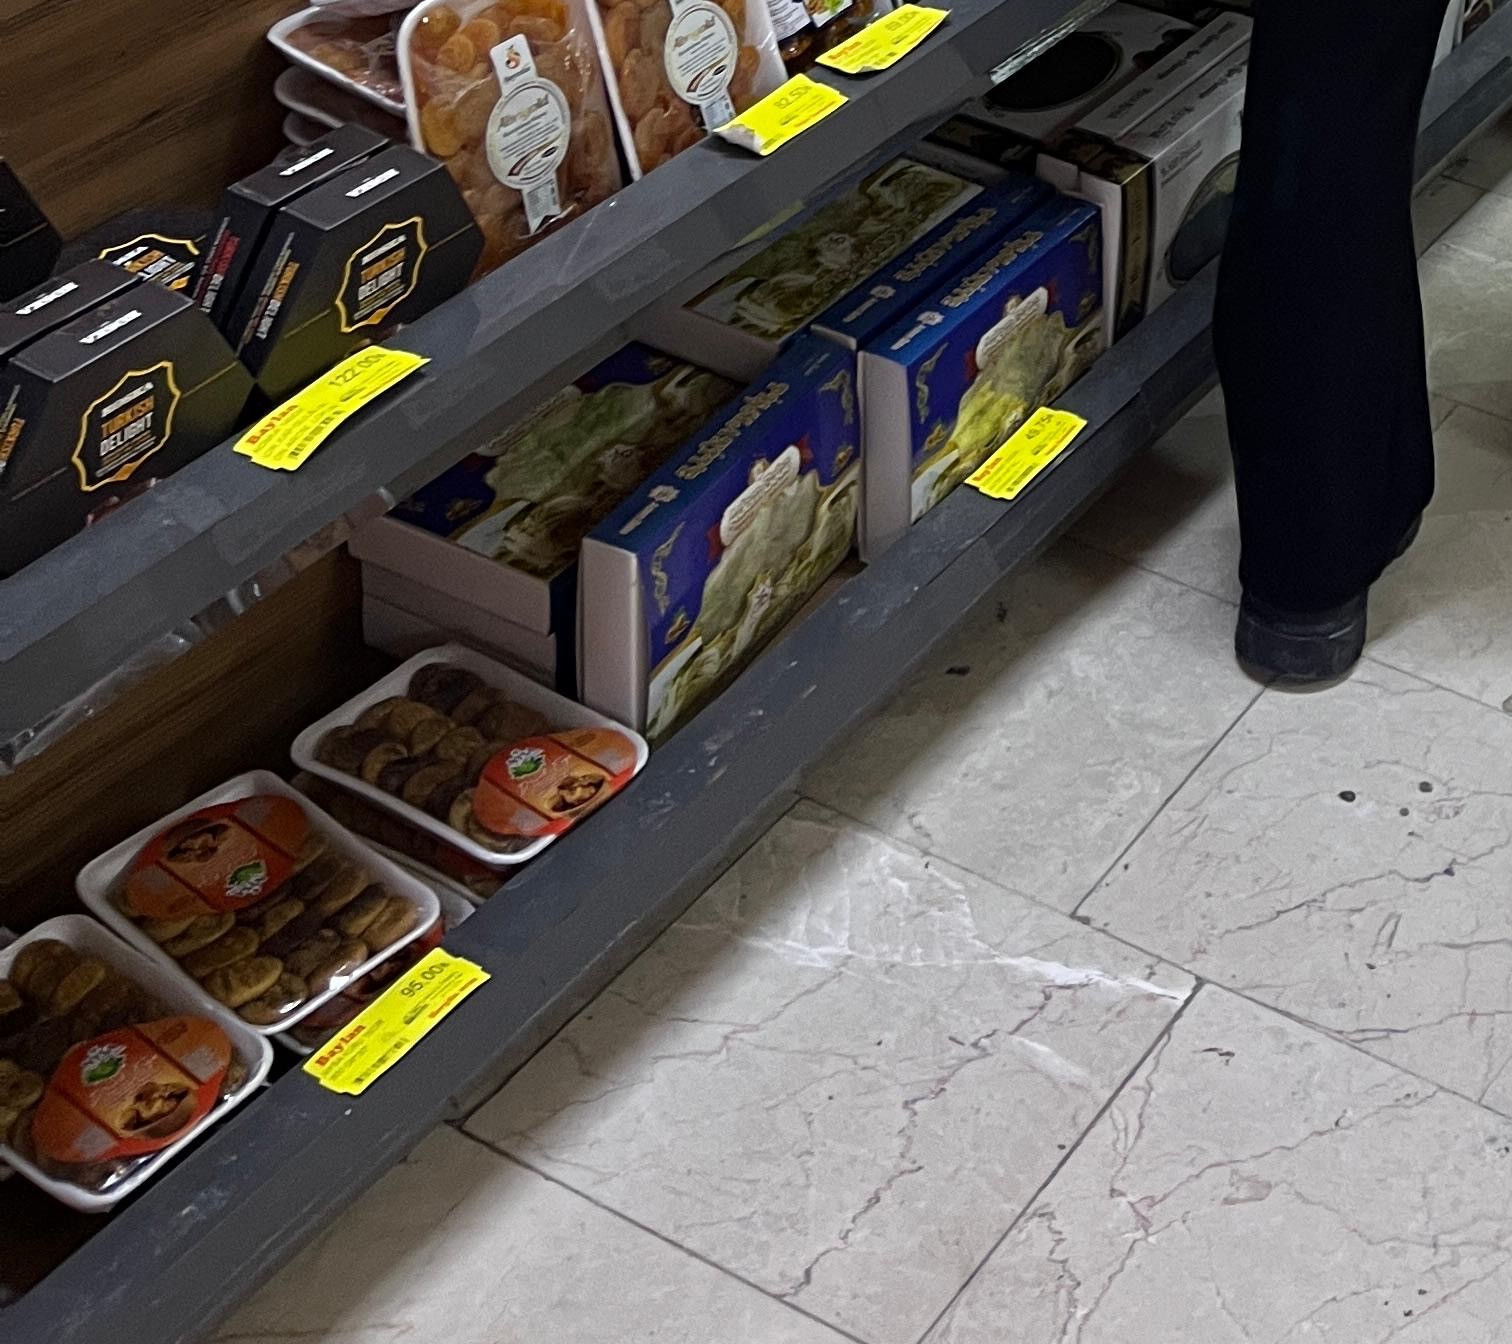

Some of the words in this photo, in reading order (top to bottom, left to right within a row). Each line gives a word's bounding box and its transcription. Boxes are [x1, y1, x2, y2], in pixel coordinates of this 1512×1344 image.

[99, 411, 154, 457] DELIGHT
[246, 403, 300, 445] Baylan
[315, 1024, 367, 1067] Baylan
